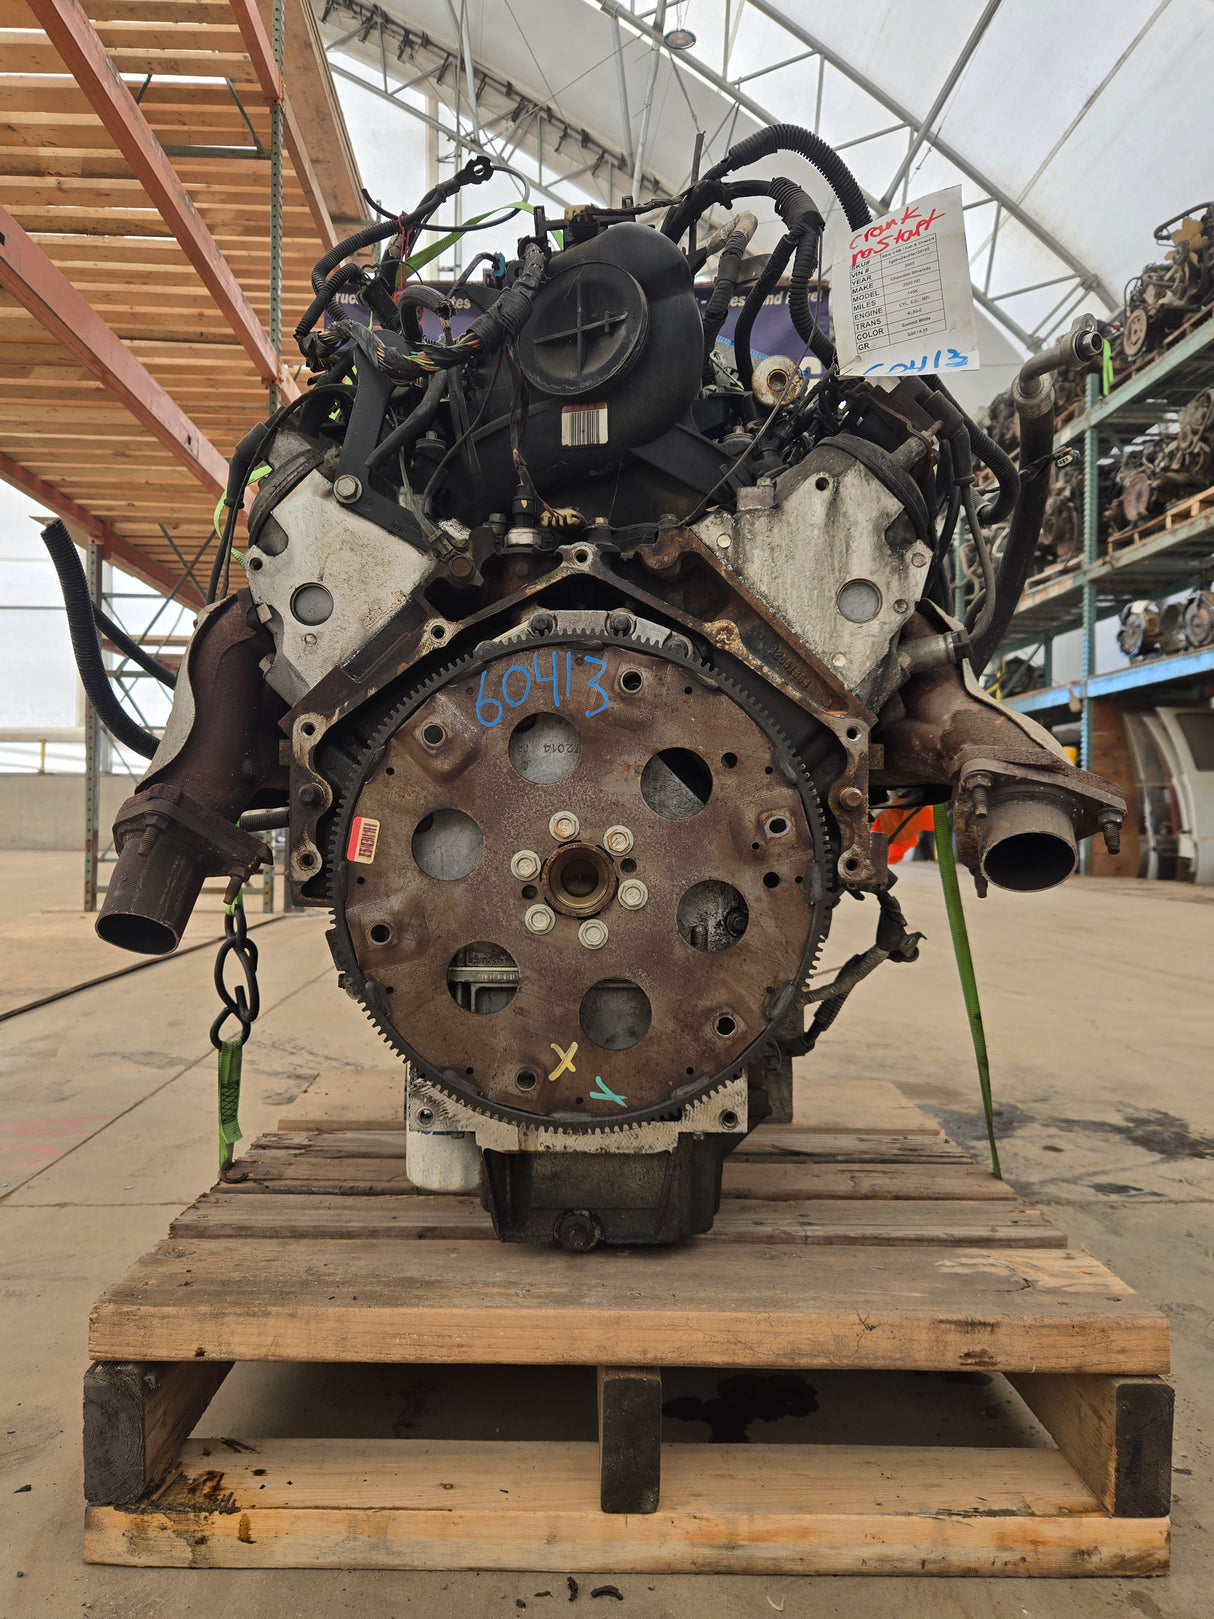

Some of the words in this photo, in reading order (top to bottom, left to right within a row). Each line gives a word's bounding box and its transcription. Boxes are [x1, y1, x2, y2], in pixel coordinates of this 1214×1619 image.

[851, 270, 863, 278] VIN
[851, 274, 872, 286] YEAR
[890, 272, 911, 281] Chevrolet
[852, 283, 874, 294] MAKE
[852, 291, 880, 303] MODEL
[853, 300, 877, 311] MILES
[854, 307, 884, 321] ENGINE
[855, 318, 882, 331] TRANS
[856, 327, 885, 341] COLOR
[857, 342, 870, 352] GR
[476, 650, 609, 727] 60413
